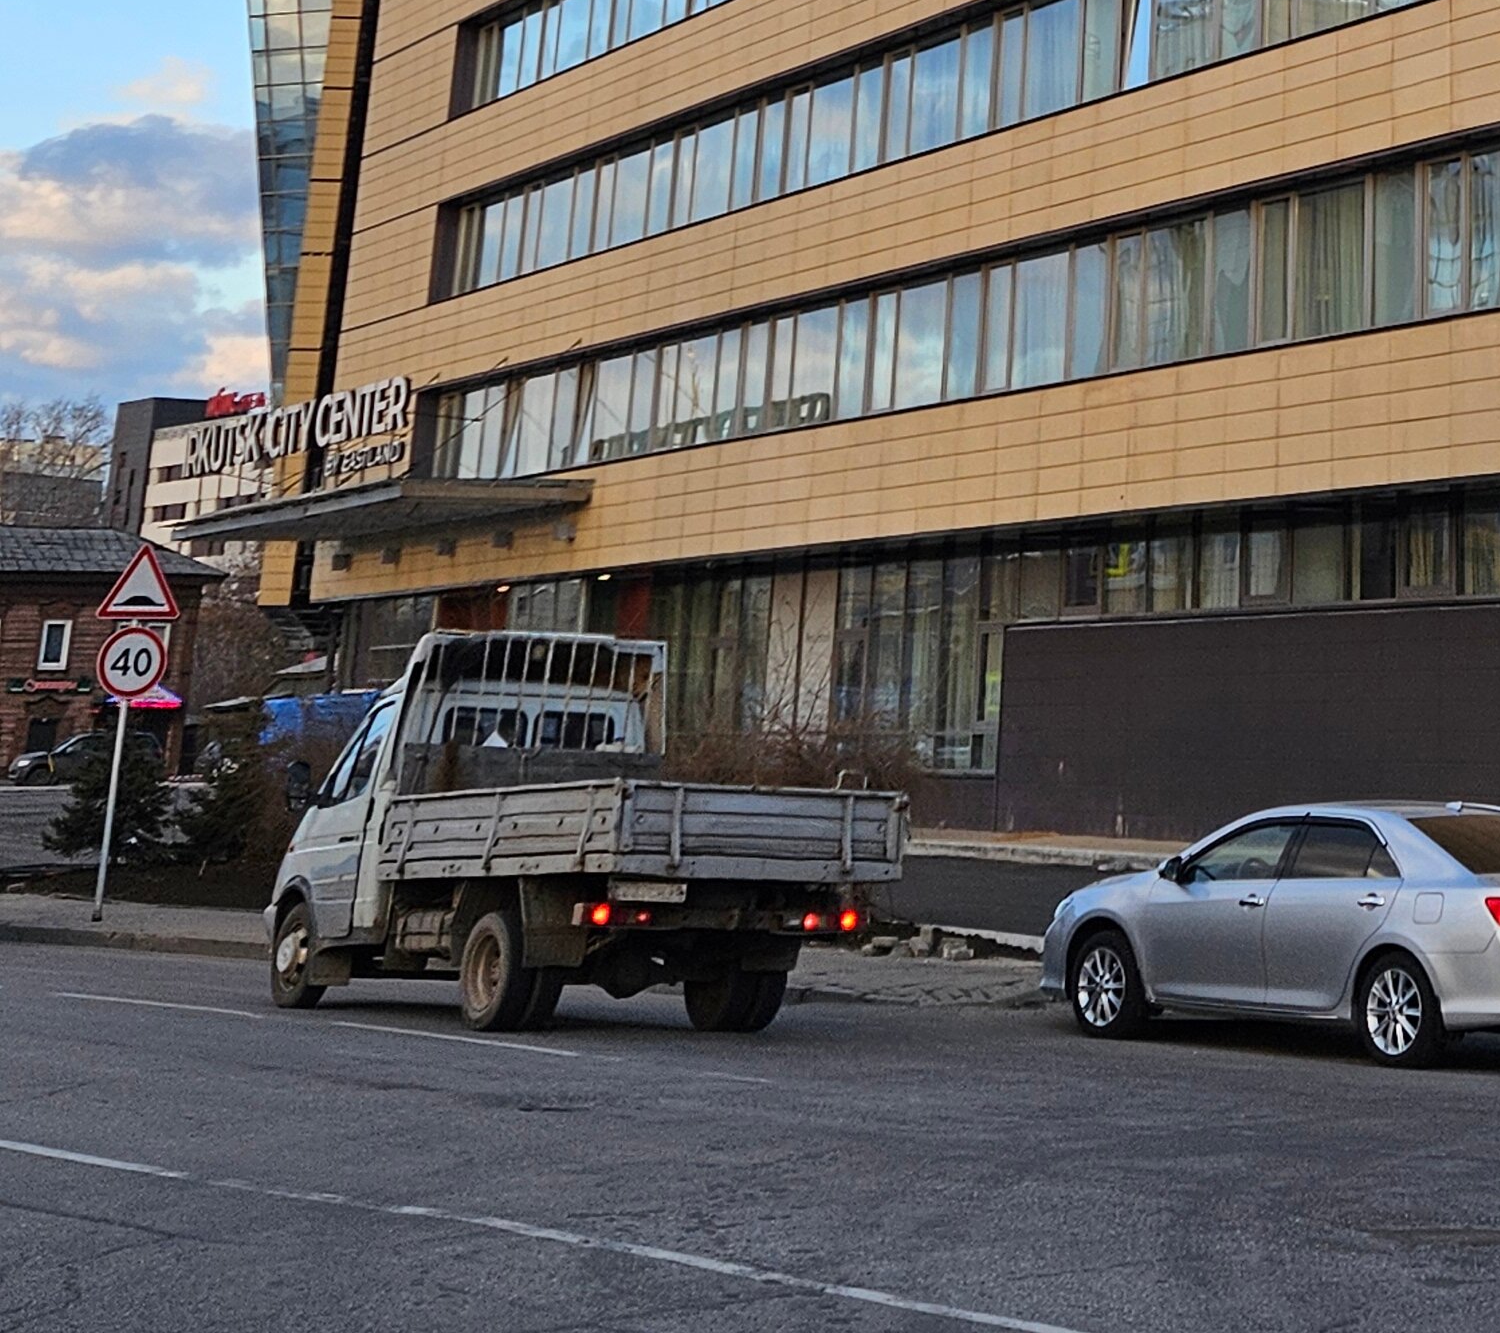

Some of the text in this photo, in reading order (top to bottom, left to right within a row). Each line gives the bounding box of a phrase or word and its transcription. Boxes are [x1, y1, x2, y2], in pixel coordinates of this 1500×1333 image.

[264, 398, 317, 460] CITY
[314, 375, 409, 448] CENTER
[110, 647, 153, 677] 40
